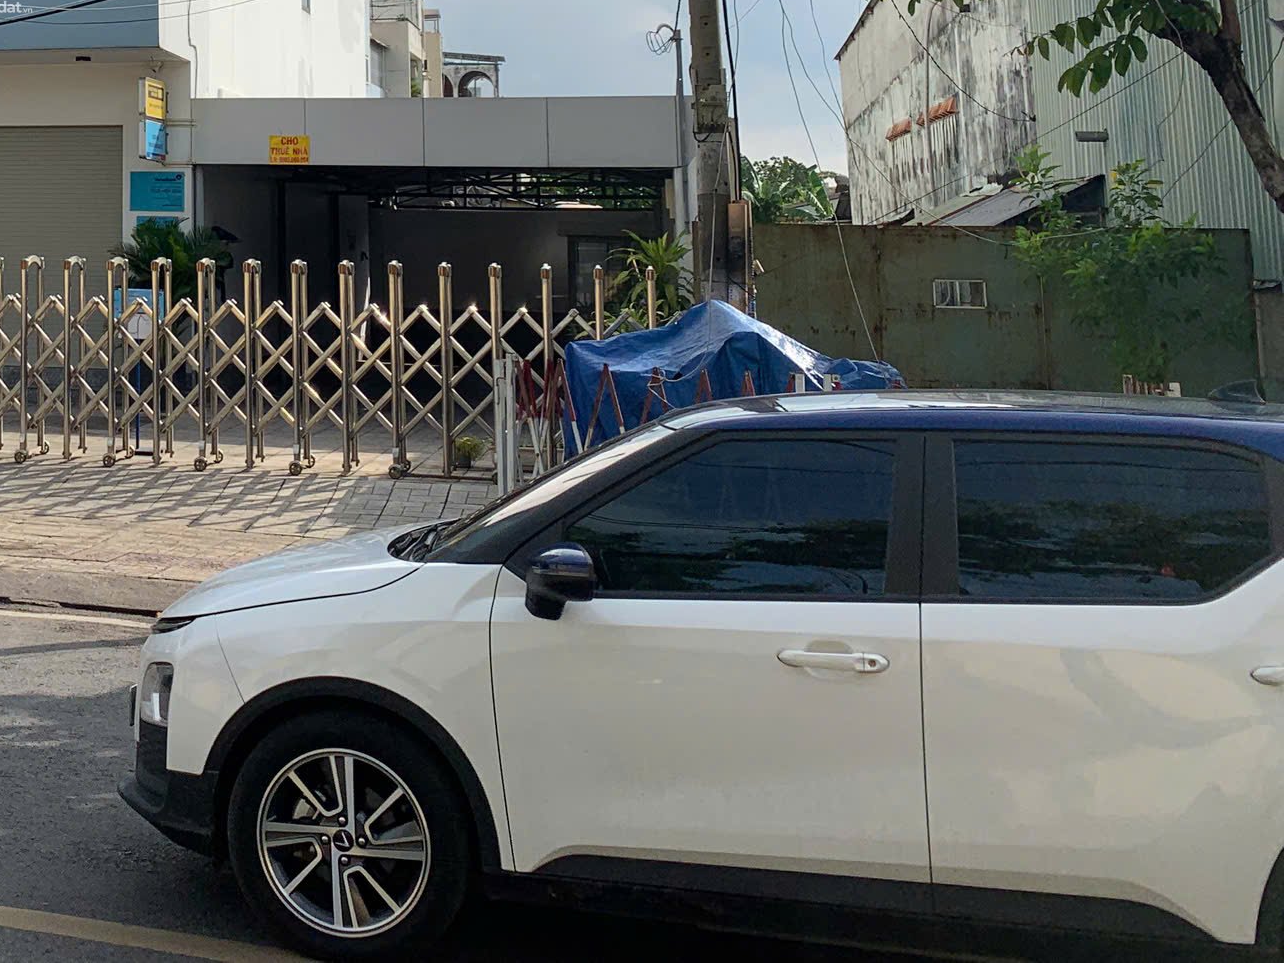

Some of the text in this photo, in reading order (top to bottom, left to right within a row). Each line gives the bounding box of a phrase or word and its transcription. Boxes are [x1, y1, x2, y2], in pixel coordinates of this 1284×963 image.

[281, 136, 299, 145] CHO
[271, 145, 308, 155] THUÊ NHÀ
